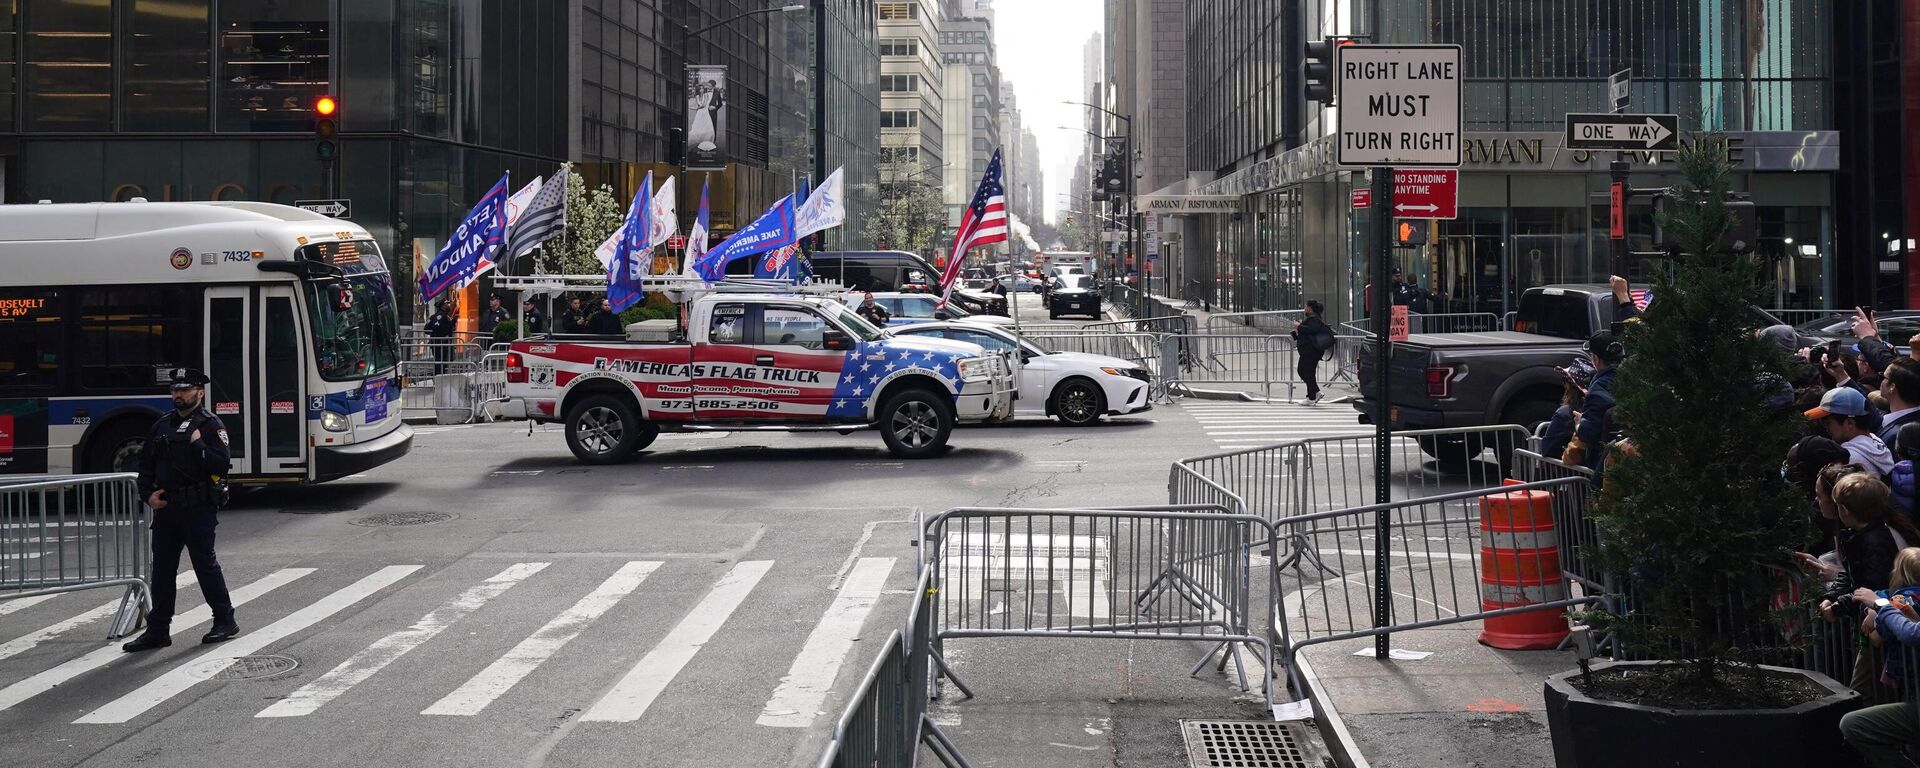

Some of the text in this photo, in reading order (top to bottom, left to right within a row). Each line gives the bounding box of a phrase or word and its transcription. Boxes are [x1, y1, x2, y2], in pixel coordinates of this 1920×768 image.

[1346, 62, 1453, 79] RIGHT LANE
[1369, 95, 1430, 116] MUST
[1582, 125, 1661, 139] ONE WAY
[1345, 132, 1454, 150] TURN RIGHT
[1463, 138, 1544, 164] RMANI
[1394, 174, 1447, 184] NO STANDING
[1395, 185, 1430, 194] ANYTIME
[326, 205, 342, 213] WAY
[1149, 200, 1180, 209] ARMANI
[1189, 200, 1240, 209] RISTORANTE
[222, 251, 250, 262] 7432
[12, 308, 27, 316] AV
[608, 359, 705, 377] AMERICA'S
[710, 365, 757, 380] FLAG
[762, 368, 820, 383] TRUCK
[894, 369, 906, 377] GOD
[919, 369, 937, 378] TRUST
[568, 372, 635, 390] ONE NATION UNDER GOD
[658, 385, 800, 395] Mount Pocono, Pennsylvania
[660, 400, 779, 409] 973-885-2506
